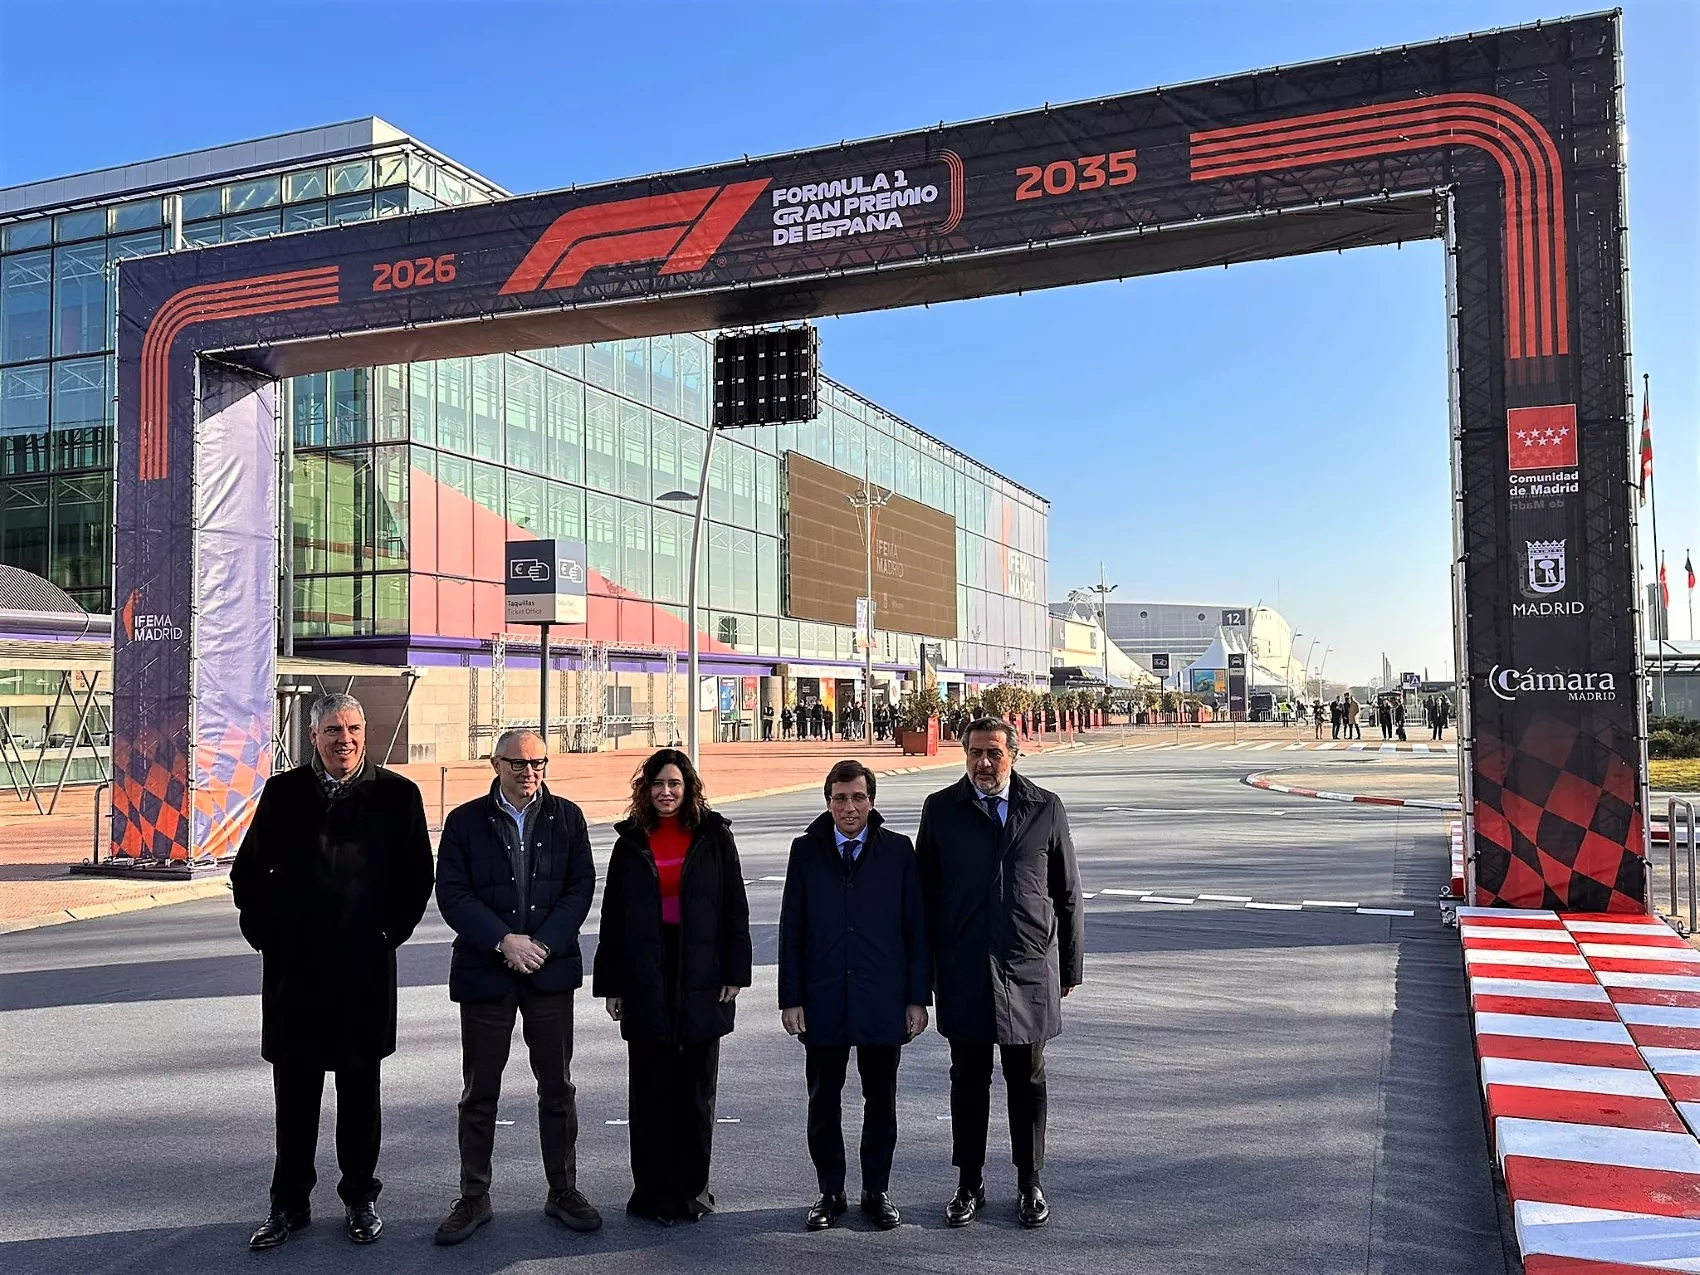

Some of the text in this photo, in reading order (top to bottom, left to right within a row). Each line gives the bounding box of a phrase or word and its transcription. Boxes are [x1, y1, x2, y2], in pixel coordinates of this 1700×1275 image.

[1015, 149, 1138, 201] 2035
[772, 170, 908, 207] FORMULA 1
[773, 185, 938, 226] GRAN PREMIO
[497, 177, 773, 295] F1
[773, 211, 903, 246] DE ESPAÑA
[373, 253, 456, 292] 2026
[1509, 471, 1579, 484] Comunidad
[1509, 486, 1526, 496] de
[1531, 482, 1579, 495] Madrid
[876, 539, 898, 559] IFEMA
[876, 557, 904, 578] MADRID
[1512, 601, 1585, 616] MADRID
[134, 614, 173, 628] IFEMA
[1226, 613, 1241, 625] 12
[134, 627, 183, 642] MADRID
[1498, 666, 1616, 691] Cámara
[1568, 691, 1616, 701] MADRID
